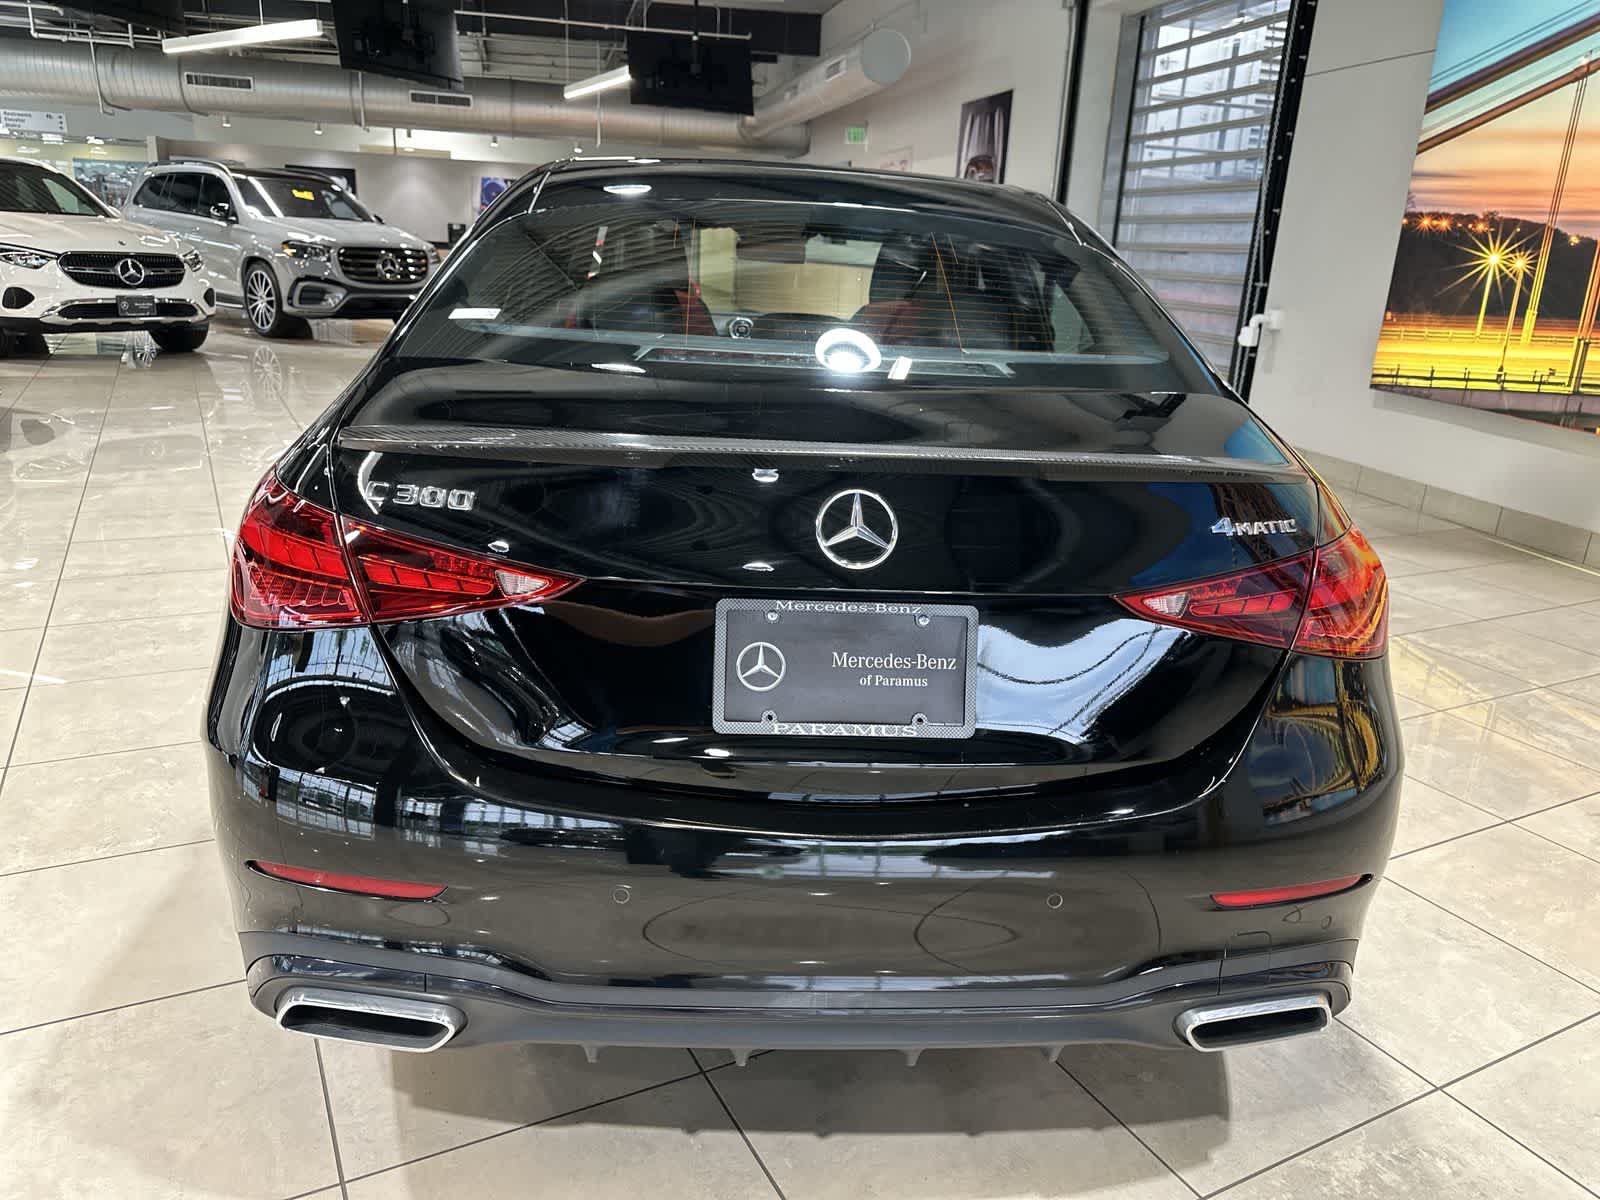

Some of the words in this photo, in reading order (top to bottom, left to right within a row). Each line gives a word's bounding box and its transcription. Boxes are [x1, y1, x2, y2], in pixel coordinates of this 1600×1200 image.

[392, 484, 476, 511] 300
[1211, 517, 1297, 537] 4MATIC
[775, 600, 922, 614] Mercedes-Benz
[832, 651, 957, 671] Mercedes-Benz
[859, 674, 873, 687] of
[875, 675, 928, 688] Paramus
[772, 723, 918, 737] PARAMUS
